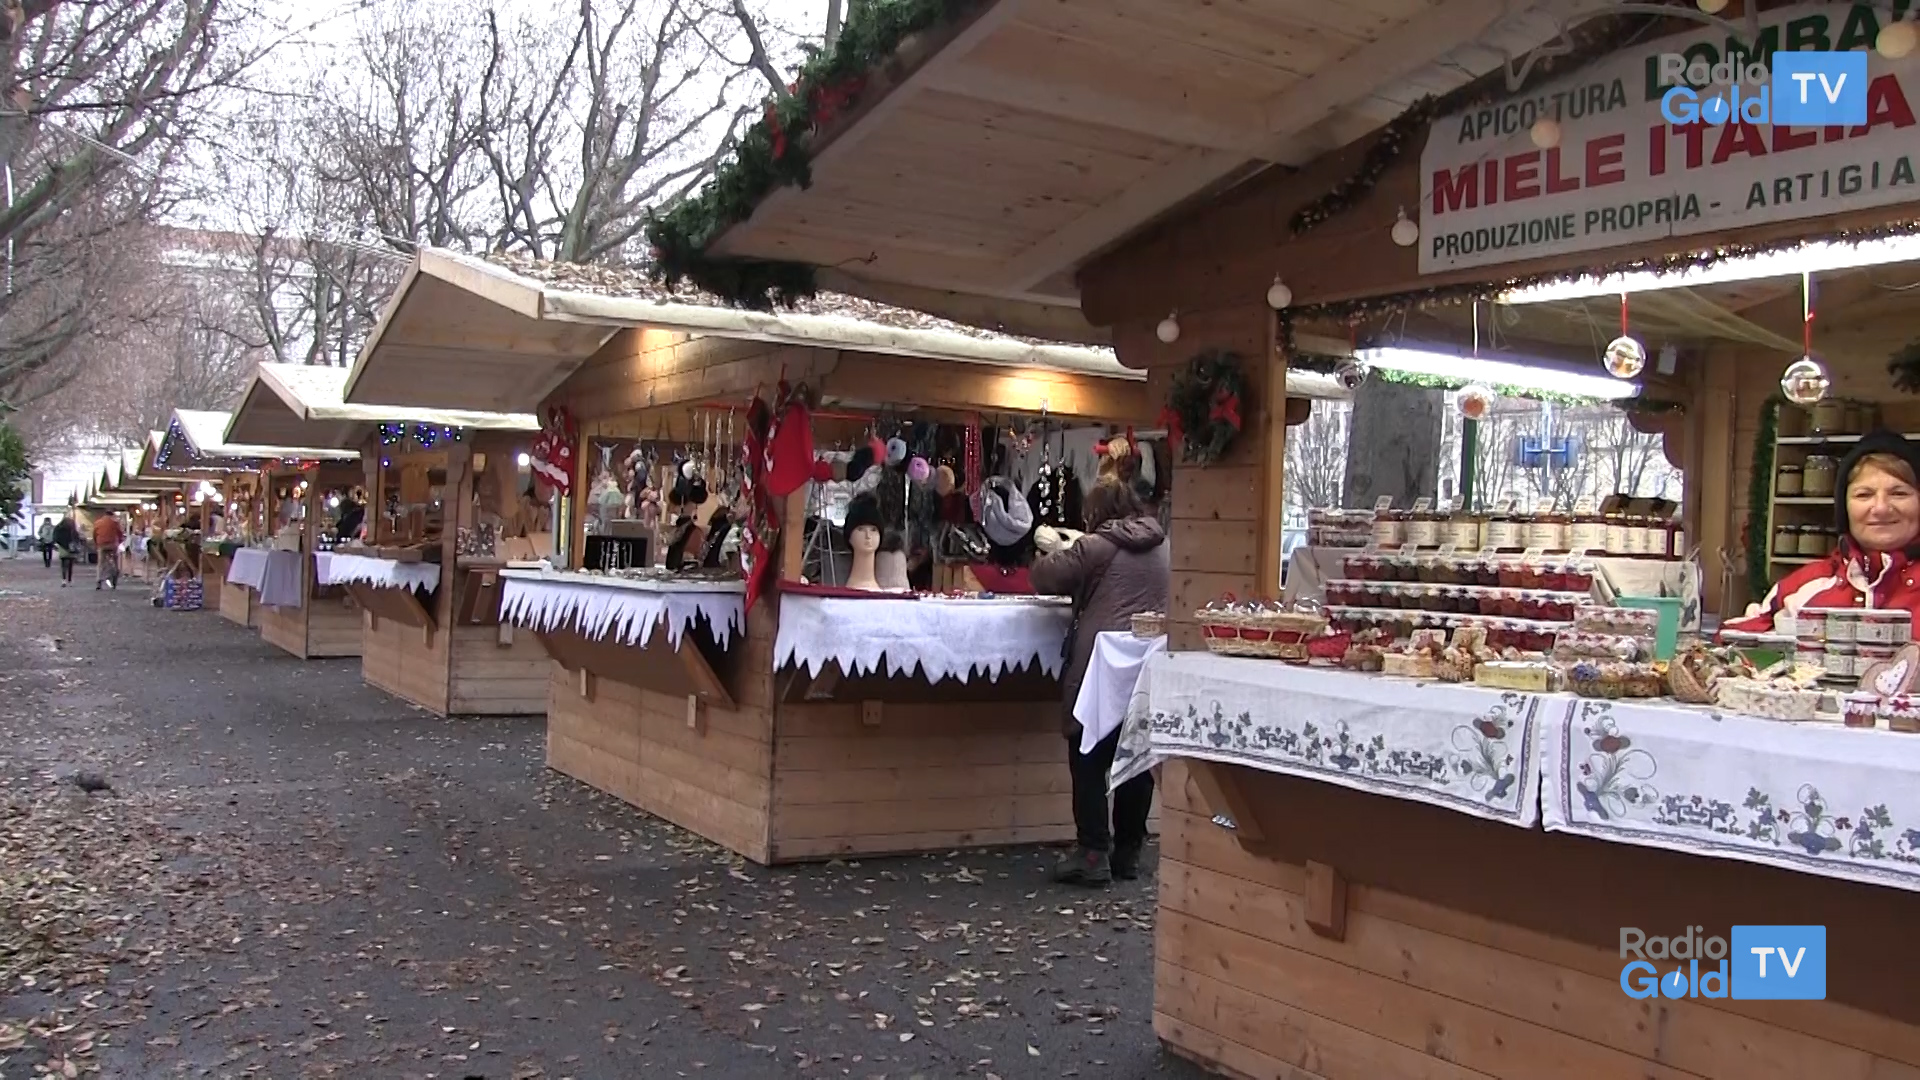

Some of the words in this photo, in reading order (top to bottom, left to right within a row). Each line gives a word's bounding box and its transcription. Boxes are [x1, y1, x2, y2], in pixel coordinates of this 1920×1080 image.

[1433, 133, 1625, 215] MIELE
[1433, 213, 1576, 258] PRODUZIONE
[1585, 193, 1701, 235] PROPRIA
[1746, 156, 1915, 210] ARTIGIA
